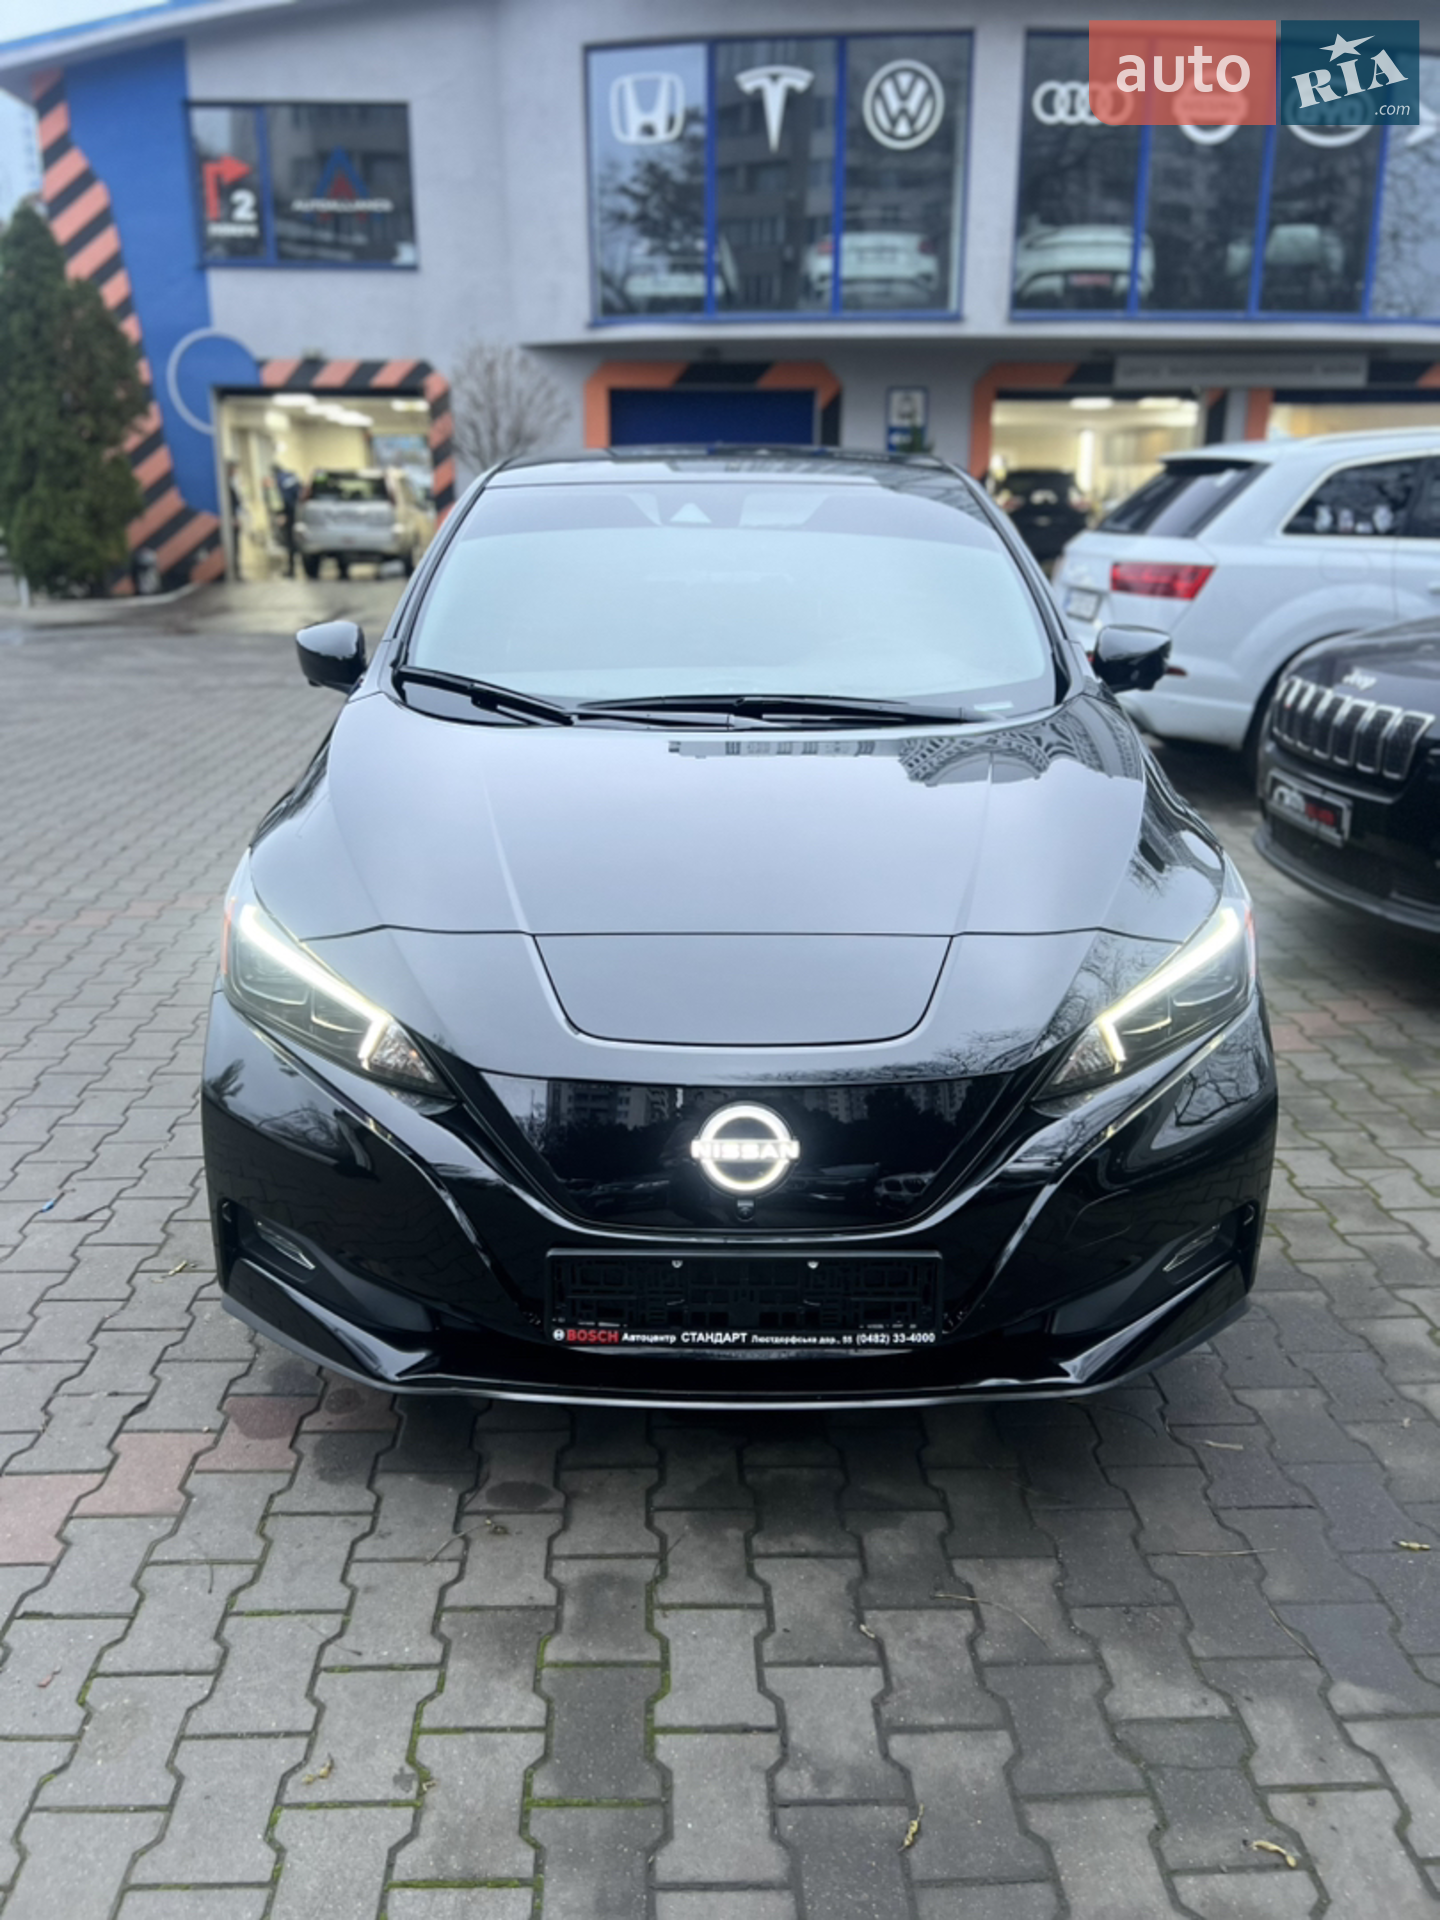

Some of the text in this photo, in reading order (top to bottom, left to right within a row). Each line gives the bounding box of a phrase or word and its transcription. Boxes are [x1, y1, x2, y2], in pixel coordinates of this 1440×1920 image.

[230, 188, 258, 221] 2
[691, 1139, 800, 1160] NISSAN
[566, 1329, 619, 1343] BOSCH
[622, 1332, 676, 1345] Автоцентр
[680, 1331, 748, 1345] СТАНДАРТ
[856, 1332, 890, 1346] (0482)
[892, 1332, 936, 1344] 33-4000
